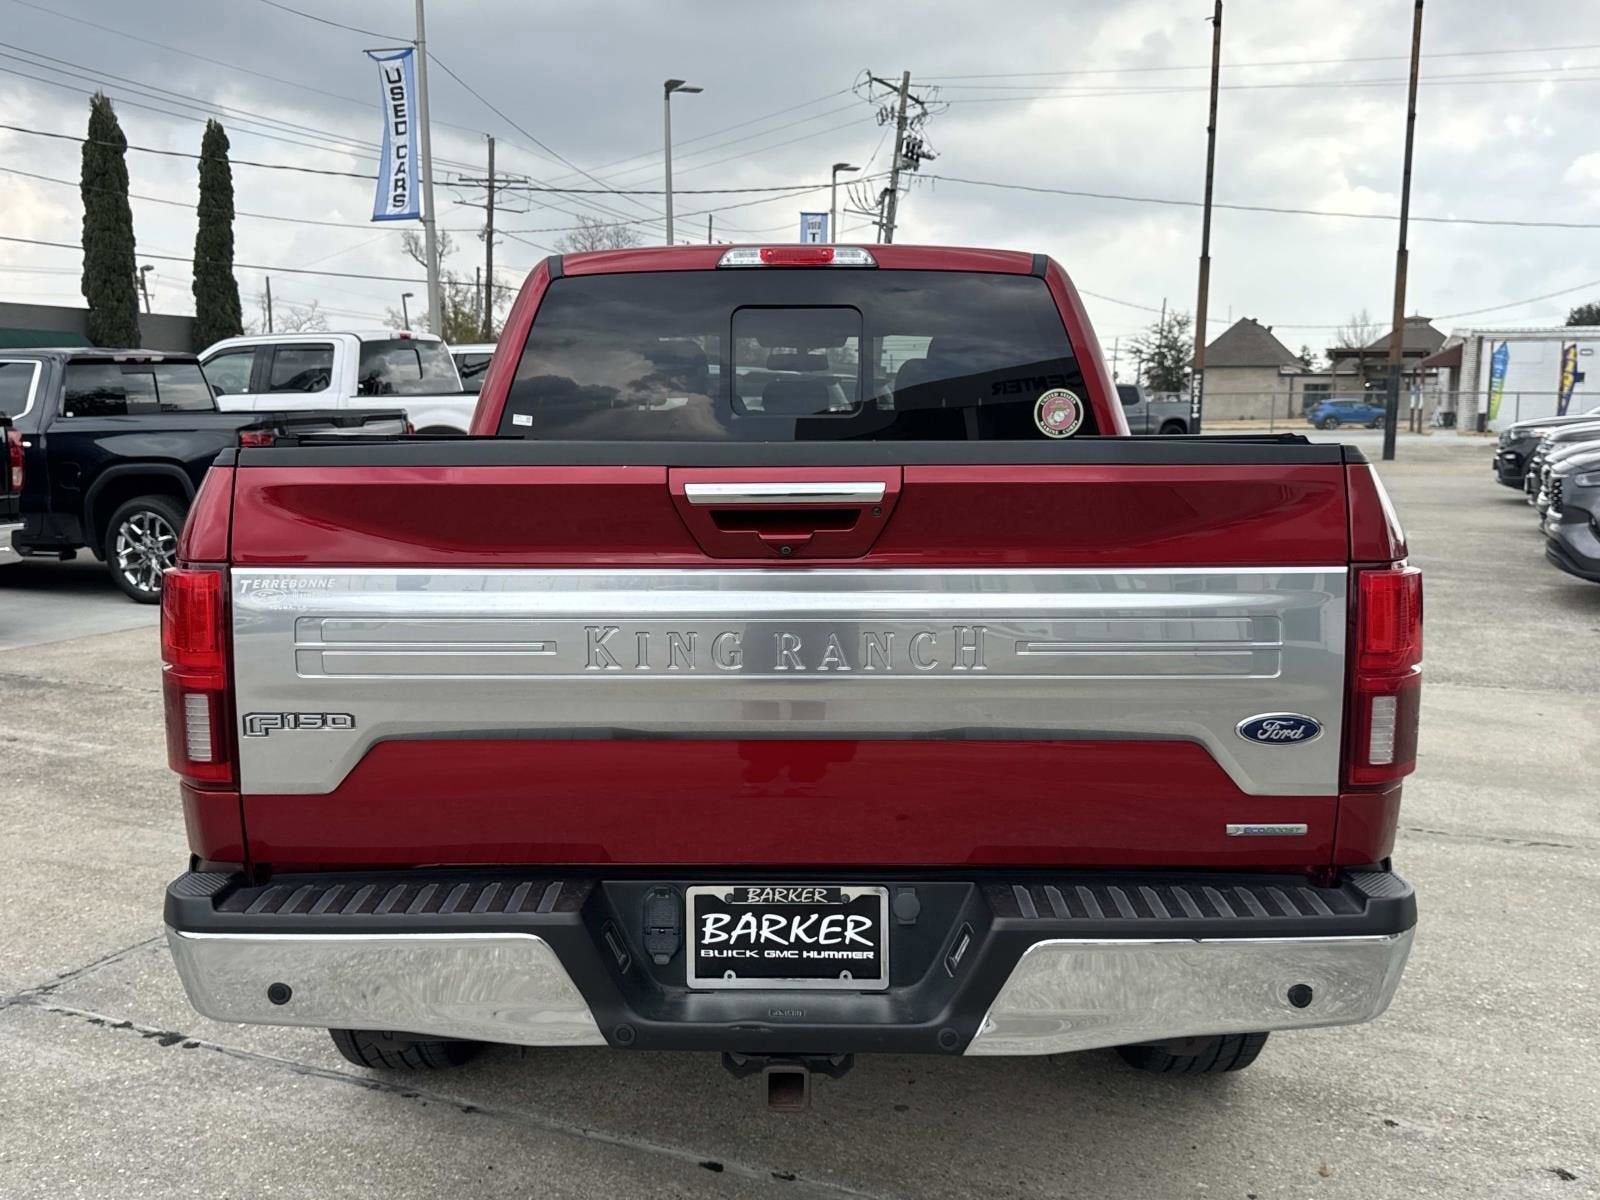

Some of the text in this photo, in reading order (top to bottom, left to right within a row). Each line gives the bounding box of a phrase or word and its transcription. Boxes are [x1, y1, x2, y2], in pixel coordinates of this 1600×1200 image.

[385, 67, 408, 208] USED CARS
[1040, 392, 1077, 406] UNITED STATES
[1040, 420, 1078, 435] MARINE CORPS
[240, 578, 336, 593] TERREBONNE
[584, 625, 988, 672] KING RANCH
[1257, 719, 1304, 740] Ford
[747, 888, 828, 903] BARKER
[701, 912, 874, 946] BARKER
[701, 949, 874, 959] BUICK GMC HUMMER
